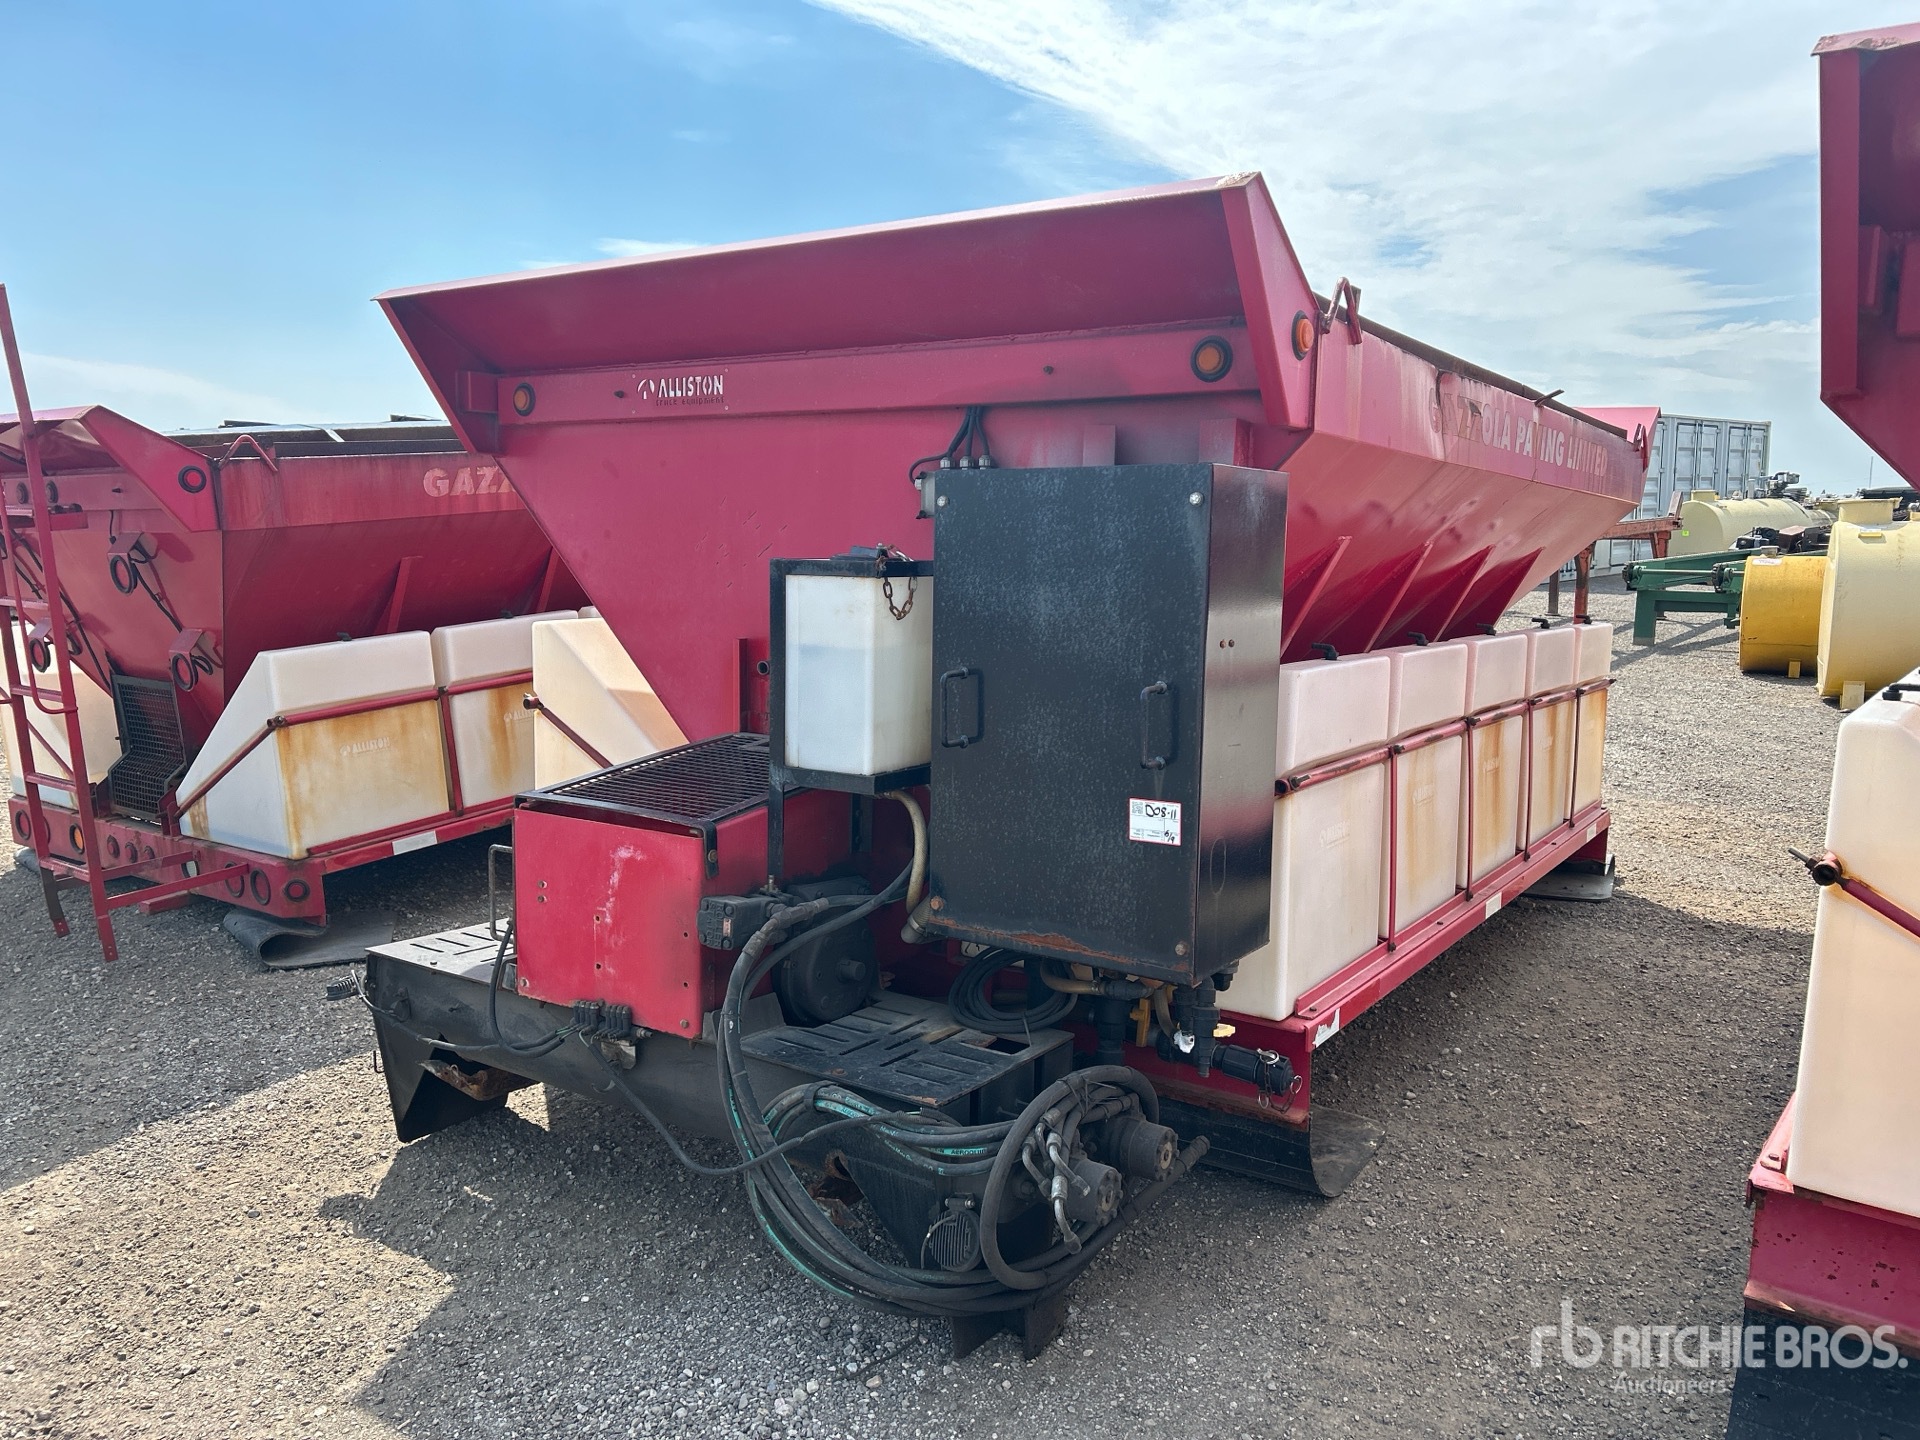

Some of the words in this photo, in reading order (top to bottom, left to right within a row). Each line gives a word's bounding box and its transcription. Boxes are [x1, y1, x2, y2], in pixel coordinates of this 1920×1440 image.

[658, 374, 724, 398] ALLISTON
[656, 397, 677, 406] truck
[682, 395, 725, 406] equipment
[1567, 436, 1609, 477] LIMITED
